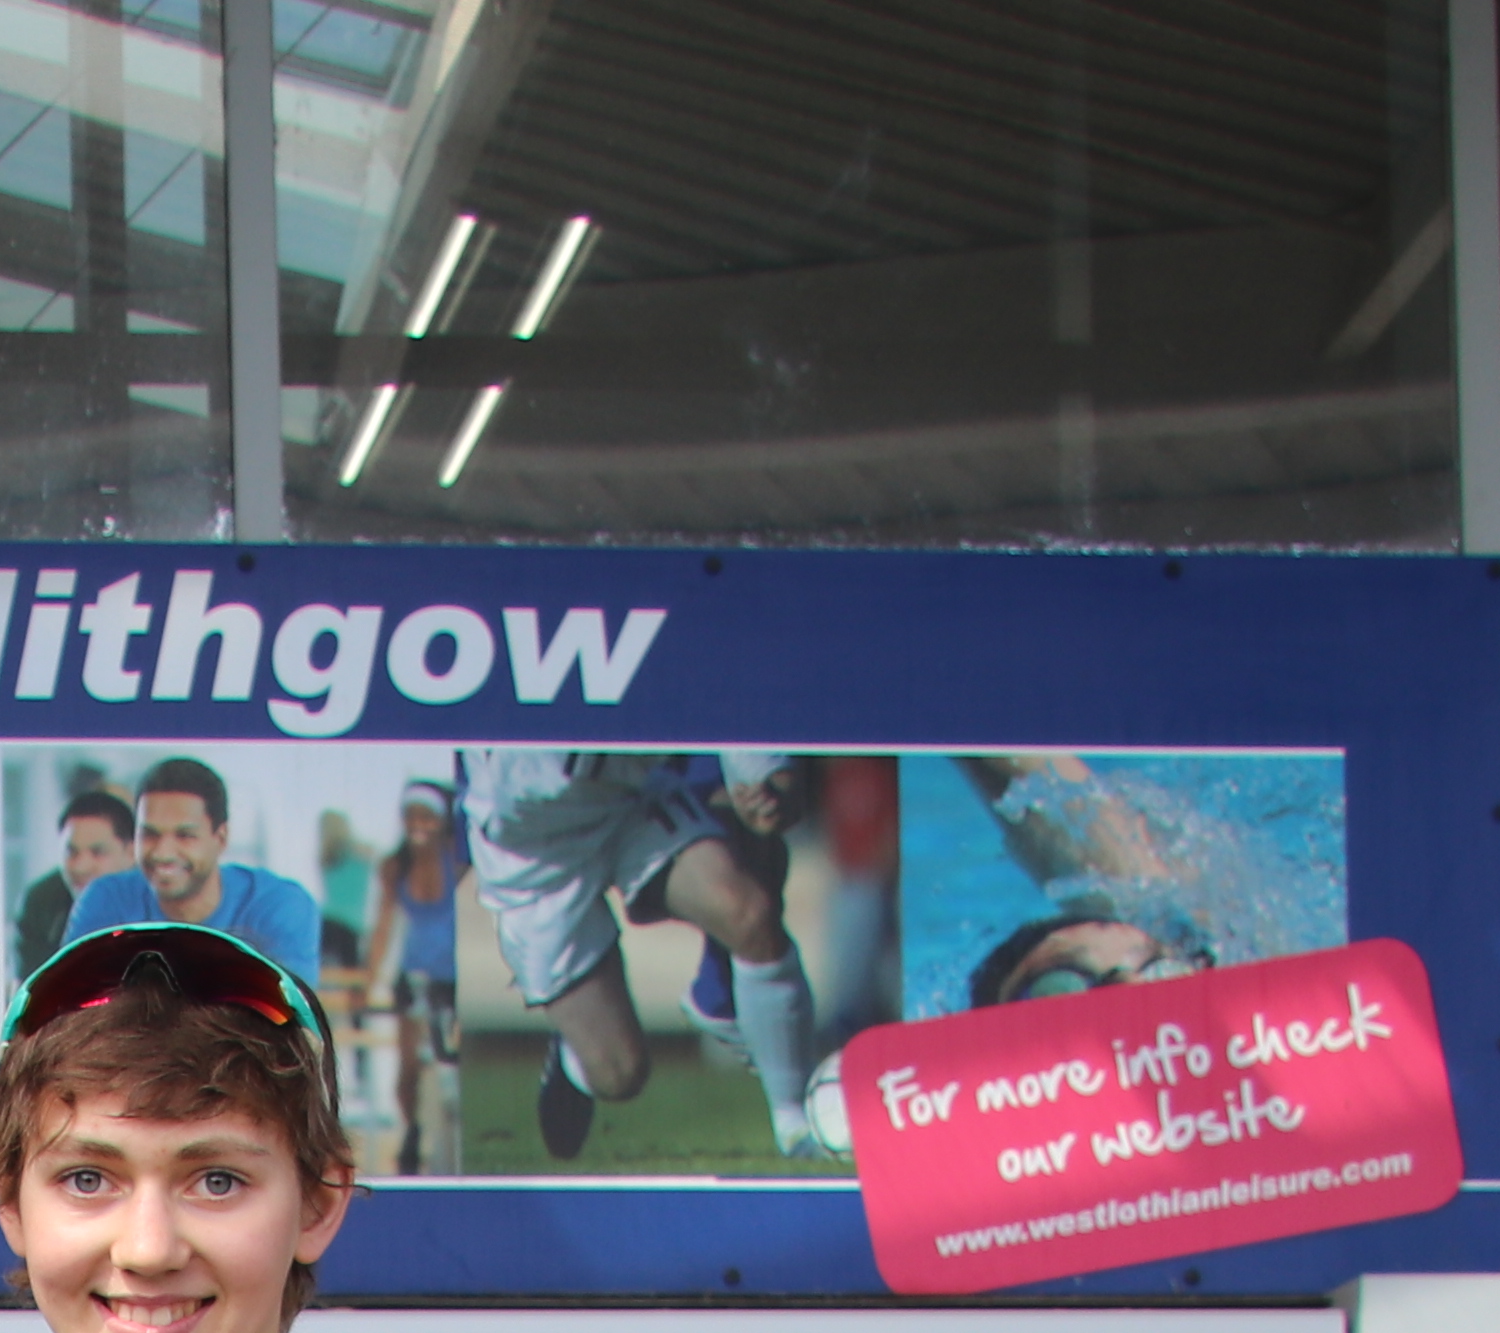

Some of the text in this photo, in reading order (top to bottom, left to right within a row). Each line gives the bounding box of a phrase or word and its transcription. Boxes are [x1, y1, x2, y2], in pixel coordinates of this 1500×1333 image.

[877, 982, 1392, 1130] For more info check
[999, 1079, 1305, 1181] our website
[935, 1152, 1412, 1258] www.westlothianleisure.com
